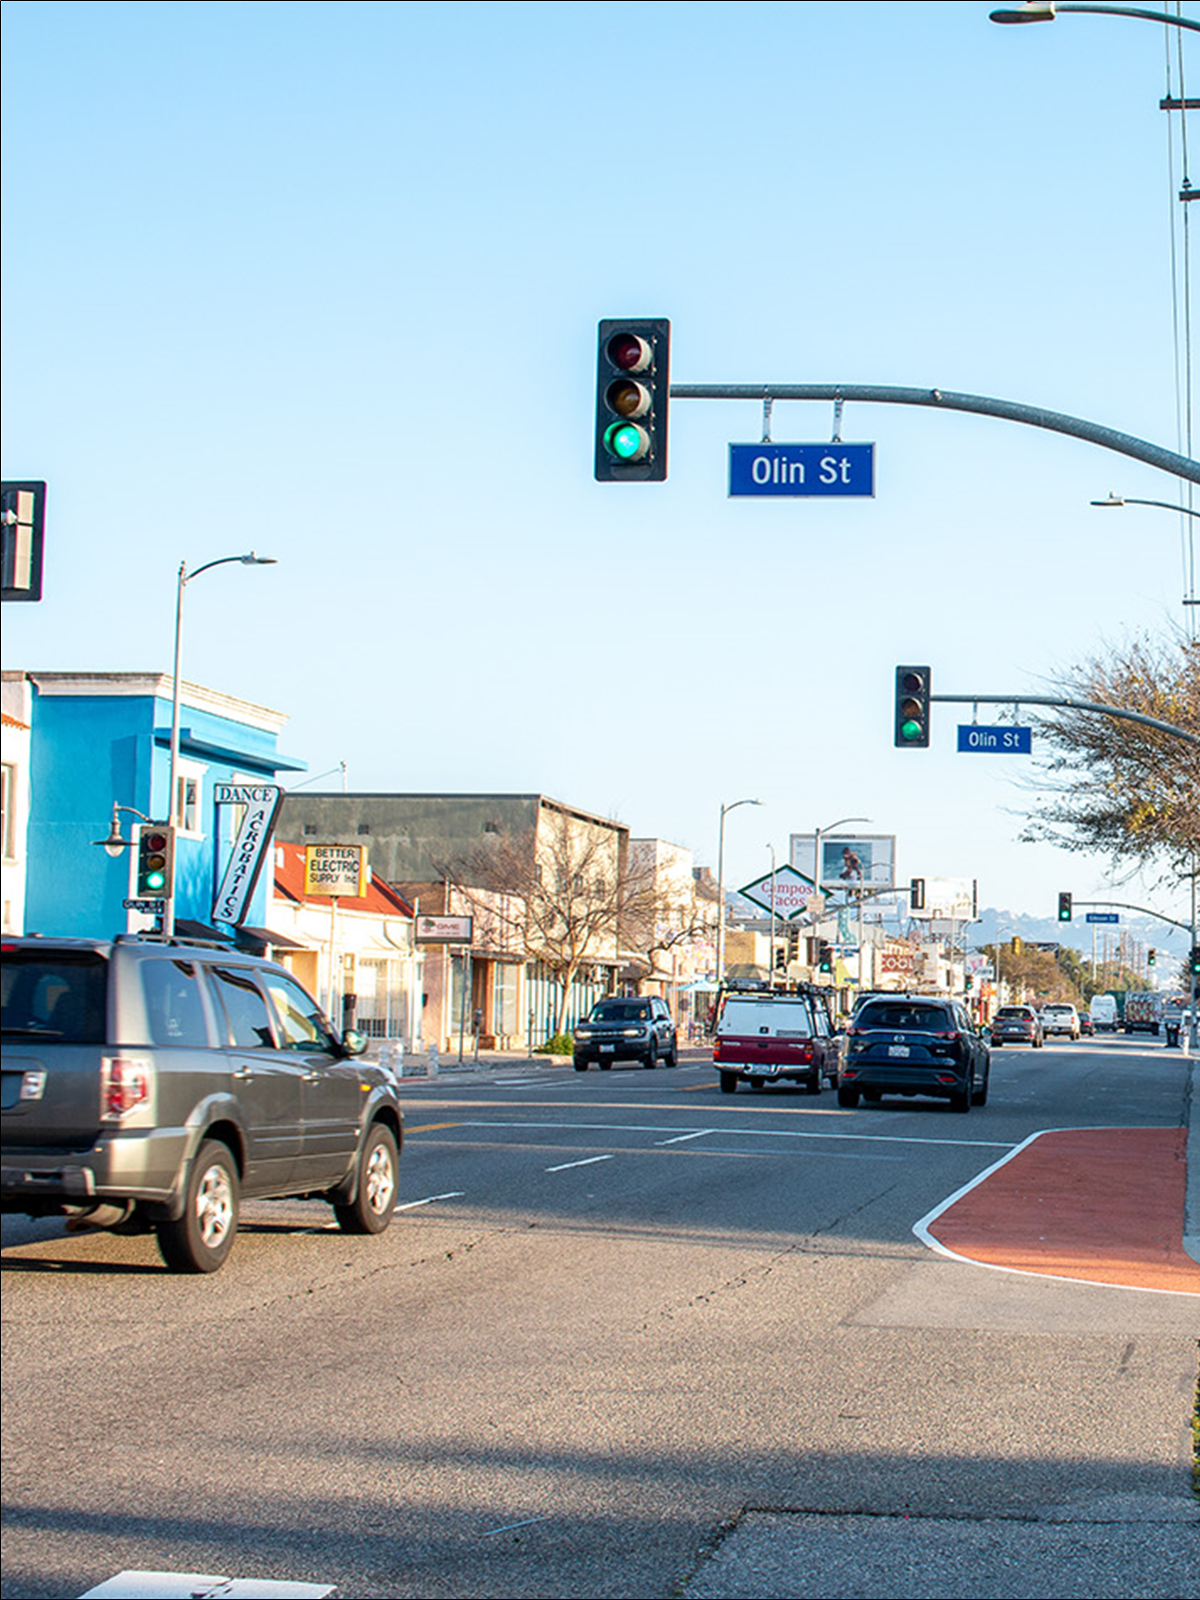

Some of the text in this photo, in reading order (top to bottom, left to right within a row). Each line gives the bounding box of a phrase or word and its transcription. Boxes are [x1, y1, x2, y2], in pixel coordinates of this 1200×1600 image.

[752, 456, 851, 484] Olin St
[968, 731, 1020, 747] Olin St
[219, 787, 272, 802] DANCE
[315, 848, 355, 858] BETTER
[221, 809, 265, 918] ACROBATICS
[309, 859, 360, 873] ELECTRIC
[309, 873, 340, 883] SUPPLY
[761, 881, 813, 896] Campos
